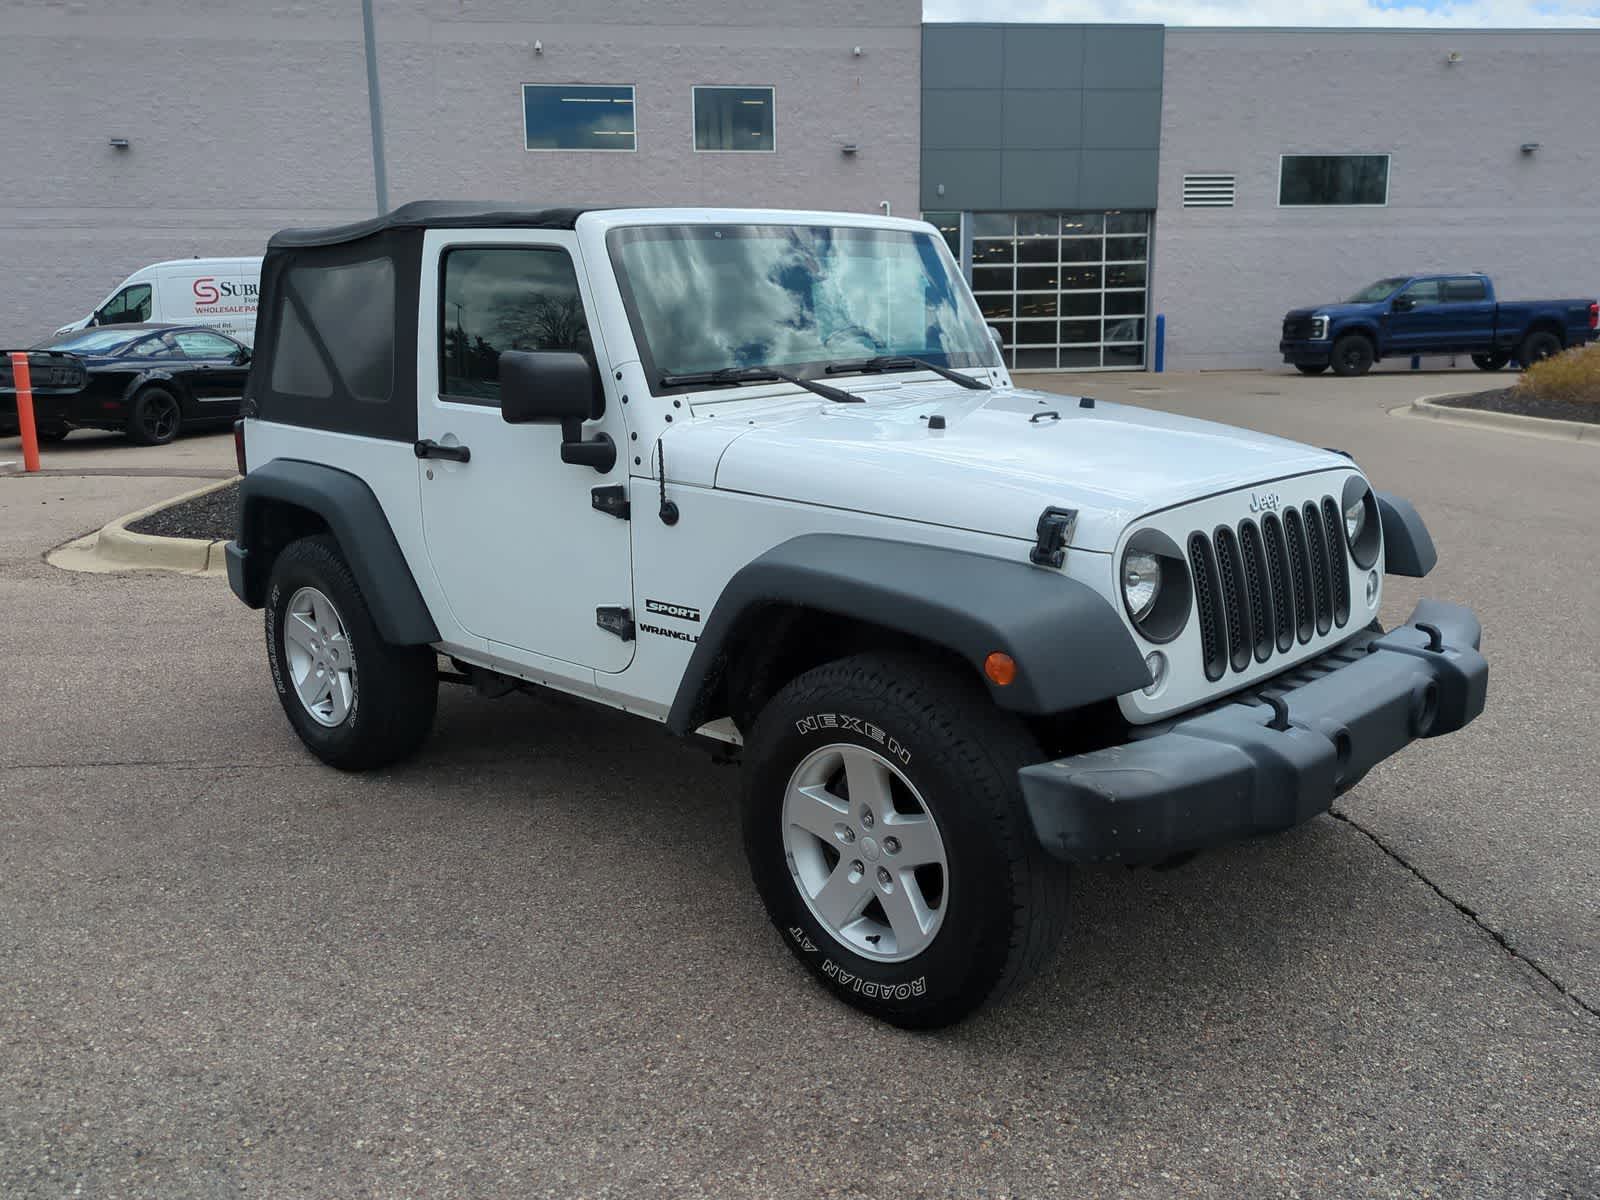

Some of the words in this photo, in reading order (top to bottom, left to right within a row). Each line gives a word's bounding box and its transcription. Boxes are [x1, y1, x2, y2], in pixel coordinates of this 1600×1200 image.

[195, 305, 243, 314] WHOLESALE
[244, 305, 258, 313] PA
[1250, 492, 1281, 513] Jeep
[648, 601, 700, 619] SPORT
[796, 713, 911, 765] NEXEN
[789, 927, 819, 952] AT
[822, 959, 927, 1000] ROADIAN
